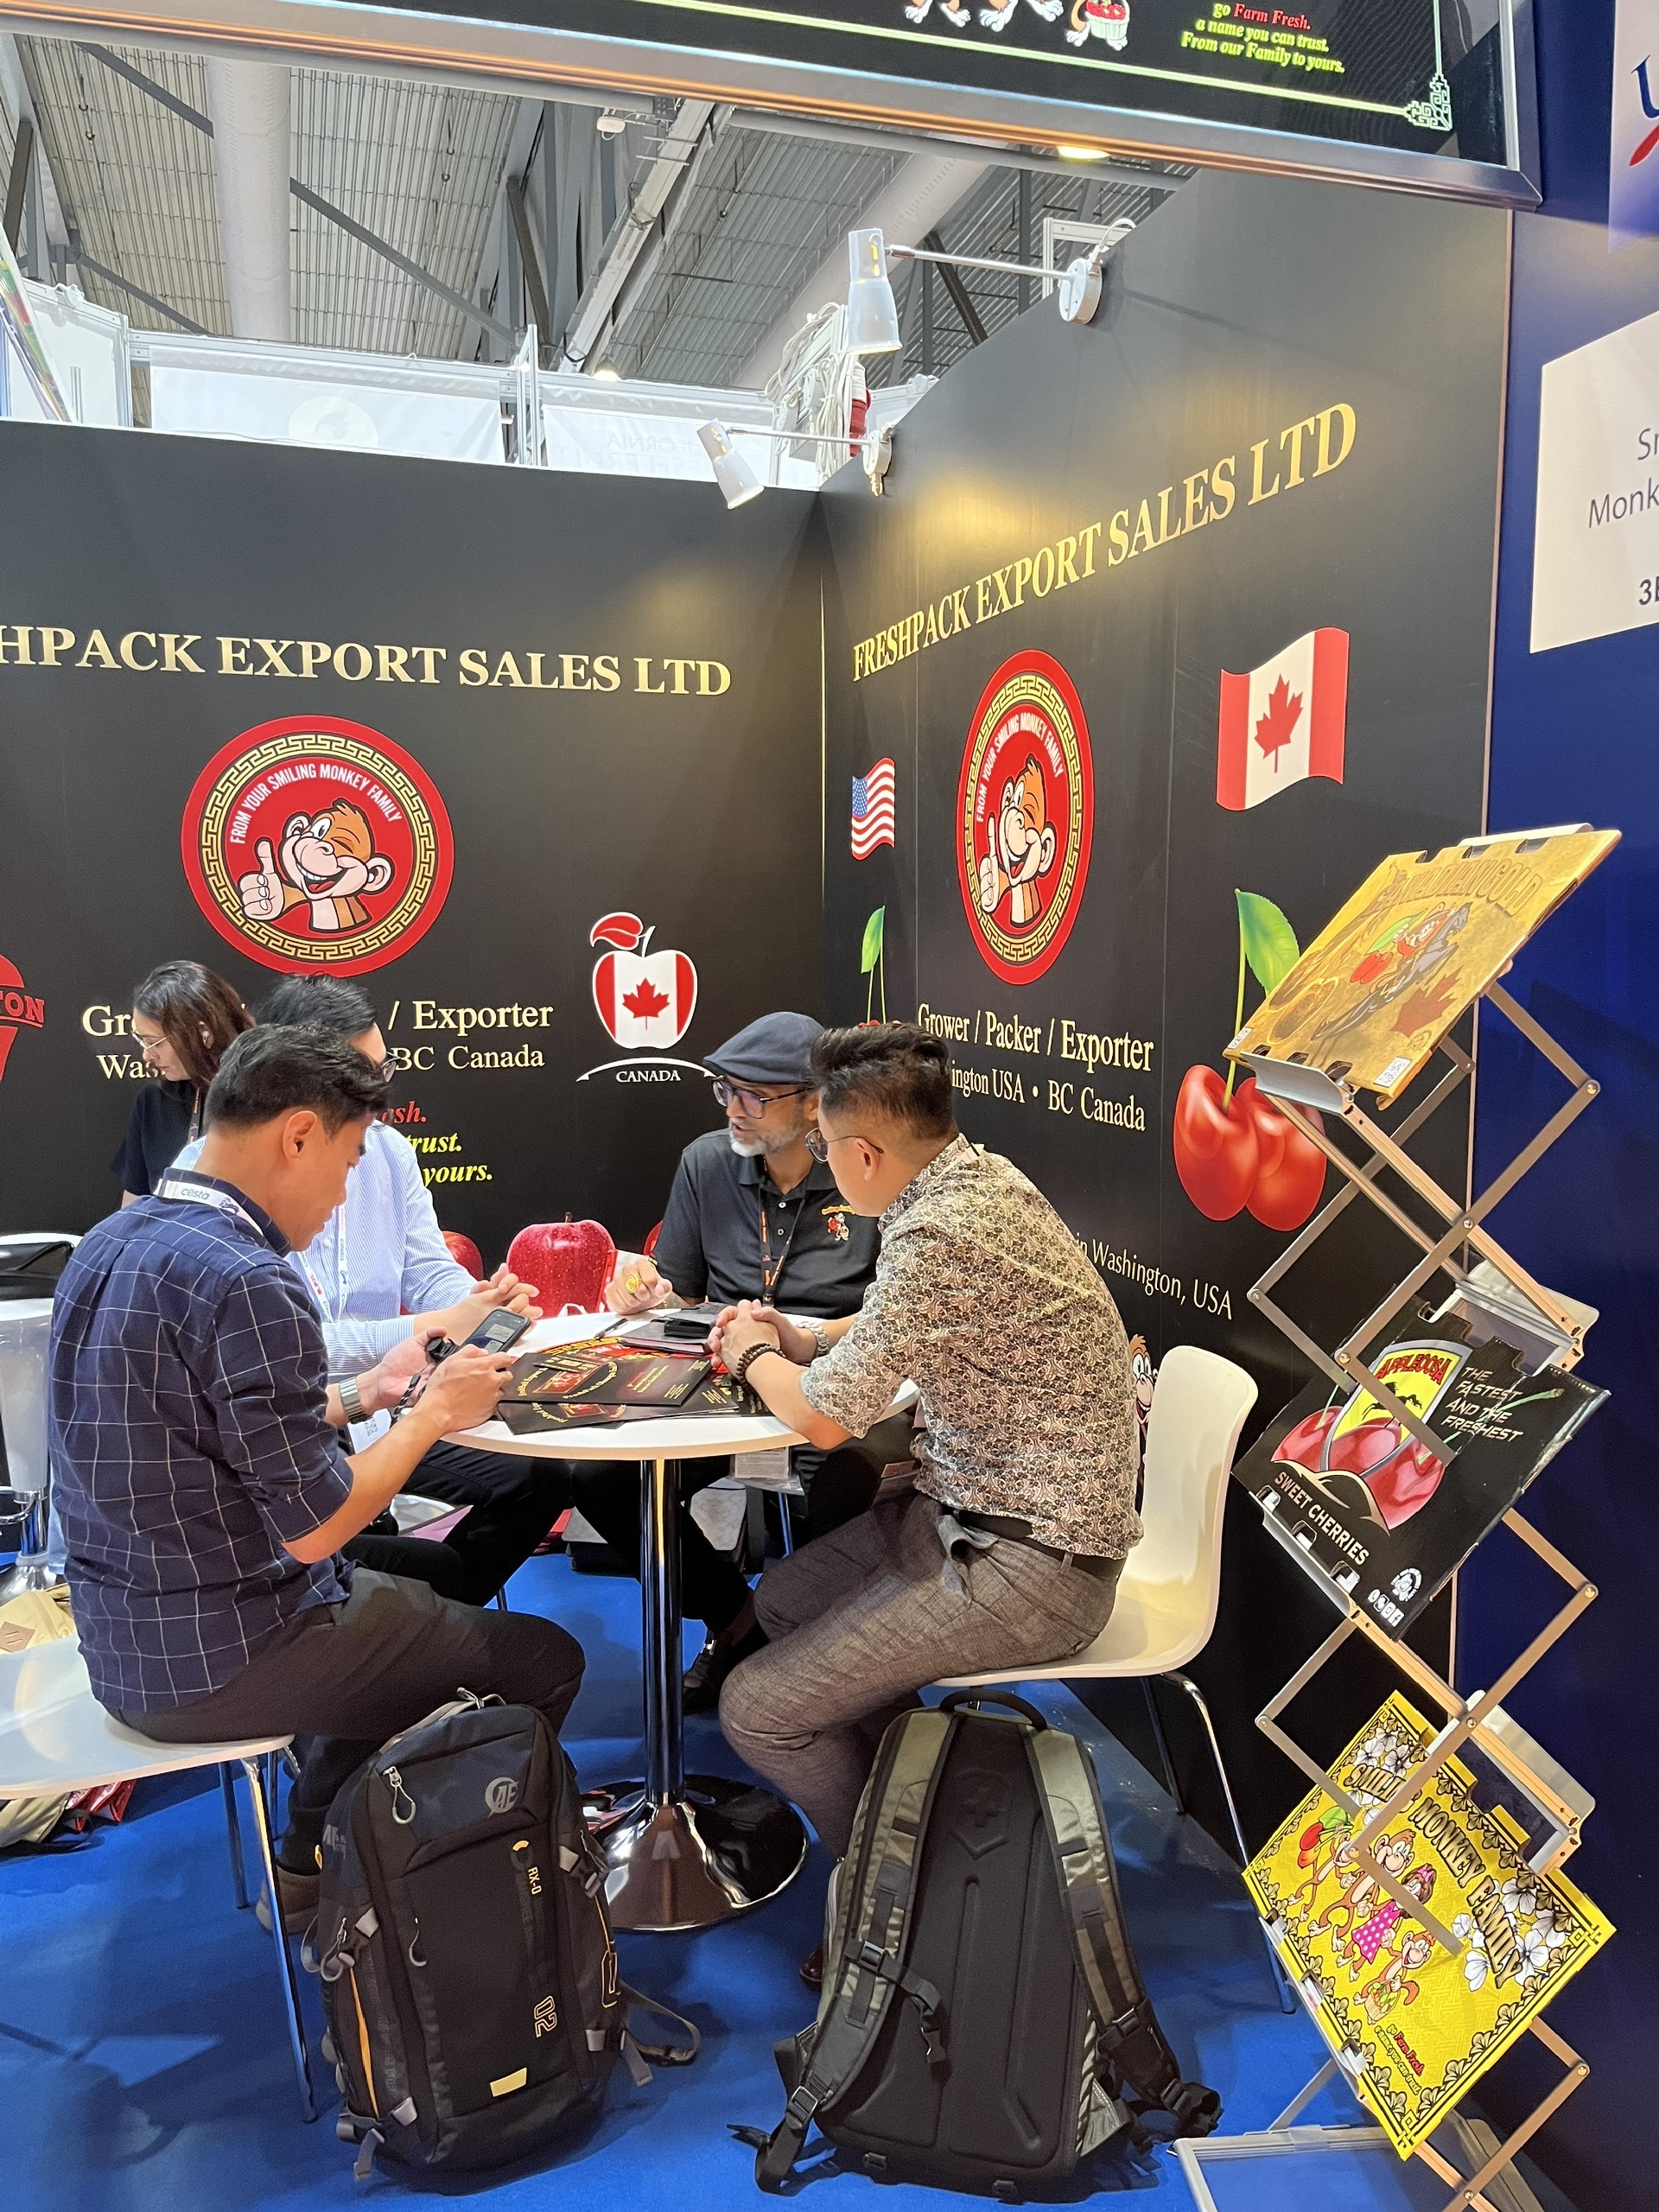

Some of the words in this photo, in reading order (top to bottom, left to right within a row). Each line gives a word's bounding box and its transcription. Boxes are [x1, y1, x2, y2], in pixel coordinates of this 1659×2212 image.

[1213, 3, 1230, 18] go
[1234, 3, 1268, 22] Farm
[1272, 10, 1312, 30] Fresh.
[1180, 30, 1218, 52] From
[1219, 41, 1244, 55] our
[1245, 41, 1292, 67] Family
[1292, 52, 1306, 66] to
[1306, 57, 1345, 73] yours.
[1195, 18, 1205, 31] a
[1207, 21, 1243, 37] name
[1244, 28, 1269, 42] you
[1270, 31, 1295, 46] can
[1297, 34, 1330, 52] trust.
[853, 585, 971, 682] FRESHPACK
[976, 522, 1102, 624] EXPORT
[1108, 454, 1236, 568] SALES
[1248, 403, 1357, 506] LTD
[216, 636, 447, 684] EXPORT
[459, 649, 621, 692] SALES
[634, 657, 732, 696] LTD
[976, 783, 988, 823] FROM
[982, 747, 997, 782] YOUR
[995, 714, 1020, 753] SMILING
[1020, 712, 1048, 741] MONKEY
[1044, 730, 1065, 778] FAMILY
[230, 808, 252, 844] FROM
[241, 782, 272, 812] YOUR
[267, 763, 317, 791] SMILING
[320, 763, 372, 791] MONKEY
[366, 784, 404, 823] FAMILY
[413, 1000, 553, 1036] Exporter
[918, 1003, 969, 1042] Grower
[985, 1011, 1042, 1054] Packer
[1060, 1020, 1154, 1074] Exporter
[391, 1046, 435, 1071] BC
[448, 1044, 544, 1070] Canada
[616, 1070, 681, 1083] CANADA
[992, 1069, 1026, 1103] USA
[1048, 1079, 1074, 1115] BC
[1080, 1086, 1146, 1132] Canada
[423, 1165, 493, 1188] yours.
[1092, 1238, 1185, 1306] Washington,
[1193, 1279, 1232, 1320] USA
[1455, 1380, 1523, 1402] FASTEST
[1461, 1367, 1493, 1381] THE
[1440, 1414, 1523, 1442] FRESHEST
[1446, 1398, 1479, 1416] AND
[1478, 1407, 1512, 1423] THE
[1274, 1471, 1313, 1510] SWEET
[1308, 1503, 1370, 1566] CHERRIES
[1408, 1796, 1486, 1889] MONKEY
[1466, 1874, 1522, 1989] FAMILY
[1394, 2031, 1409, 2054] Farm
[1387, 2048, 1402, 2064] you
[1397, 2062, 1409, 2077] can
